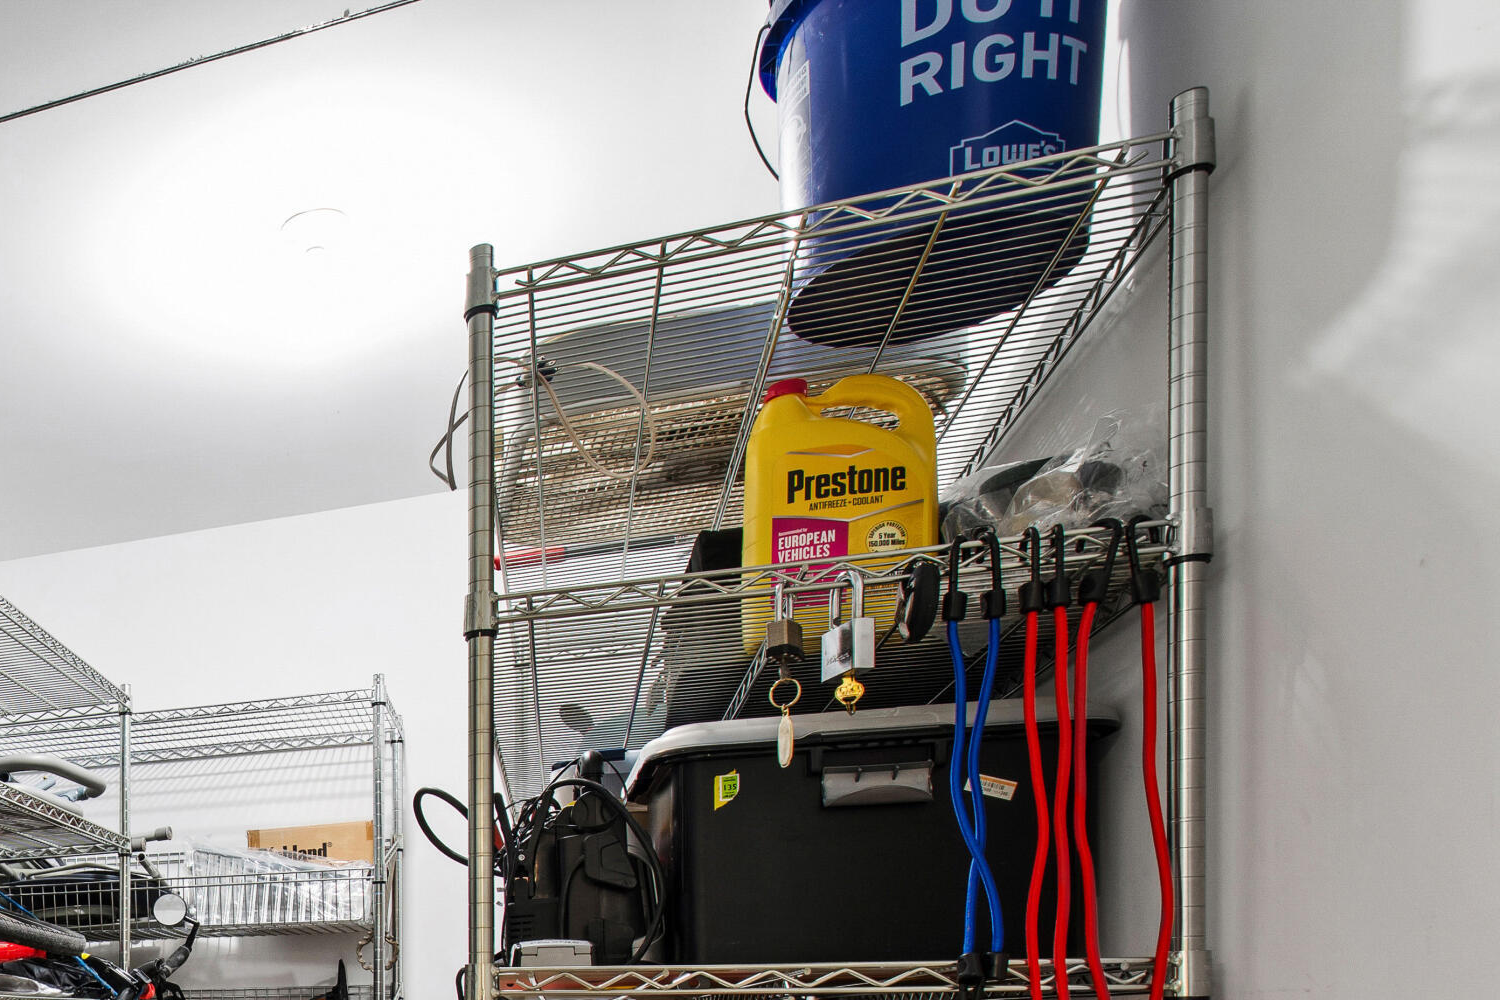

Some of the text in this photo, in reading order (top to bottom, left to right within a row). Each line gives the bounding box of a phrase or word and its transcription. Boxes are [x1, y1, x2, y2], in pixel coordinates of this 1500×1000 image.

[900, 32, 1087, 107] RIGHT
[787, 464, 906, 504] Prestone
[809, 498, 847, 512] ANTIFREEZE
[852, 495, 884, 506] COOLANT
[778, 529, 836, 550] EUROPEAN
[778, 544, 830, 563] VEHICLES
